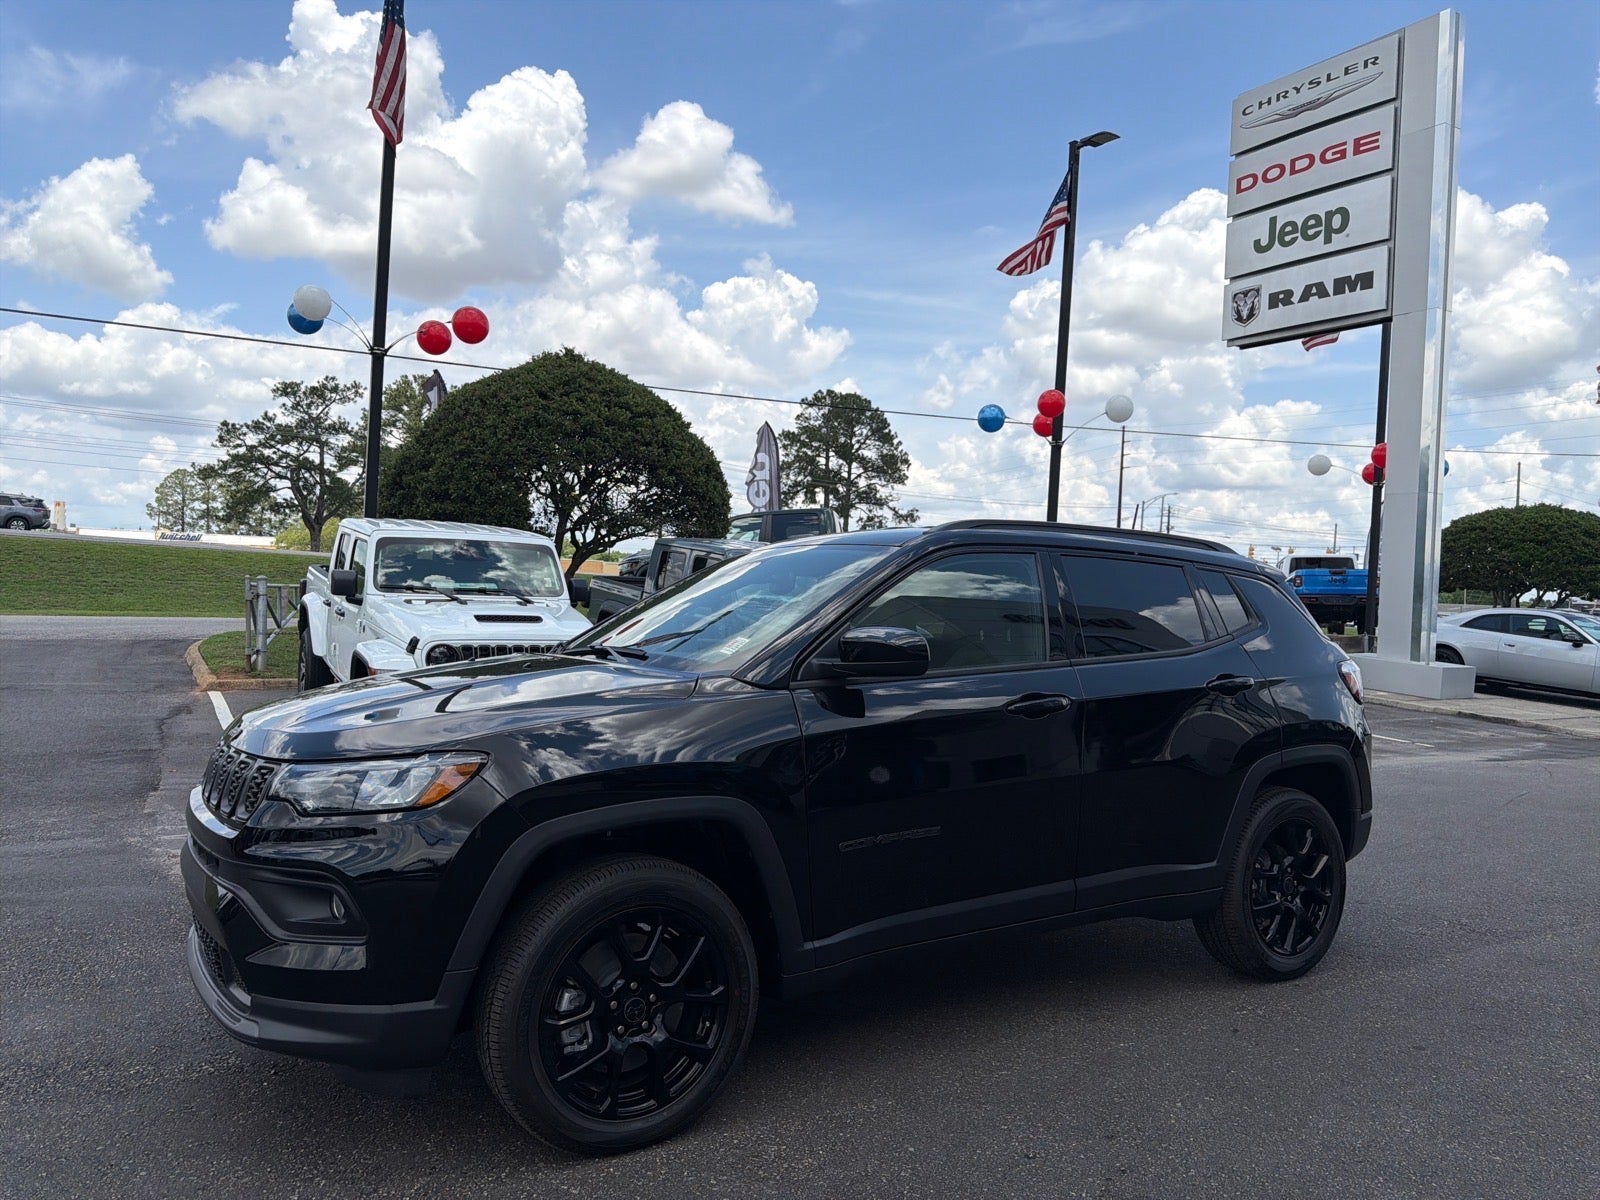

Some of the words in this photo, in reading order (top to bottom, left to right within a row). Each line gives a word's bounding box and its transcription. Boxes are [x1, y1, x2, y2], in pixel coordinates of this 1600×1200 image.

[1241, 55, 1380, 117] CHRYSLER
[1235, 130, 1381, 195] DODGE
[1253, 205, 1351, 255] Jeep
[1267, 270, 1375, 310] RAM
[1328, 576, 1348, 584] Jeep
